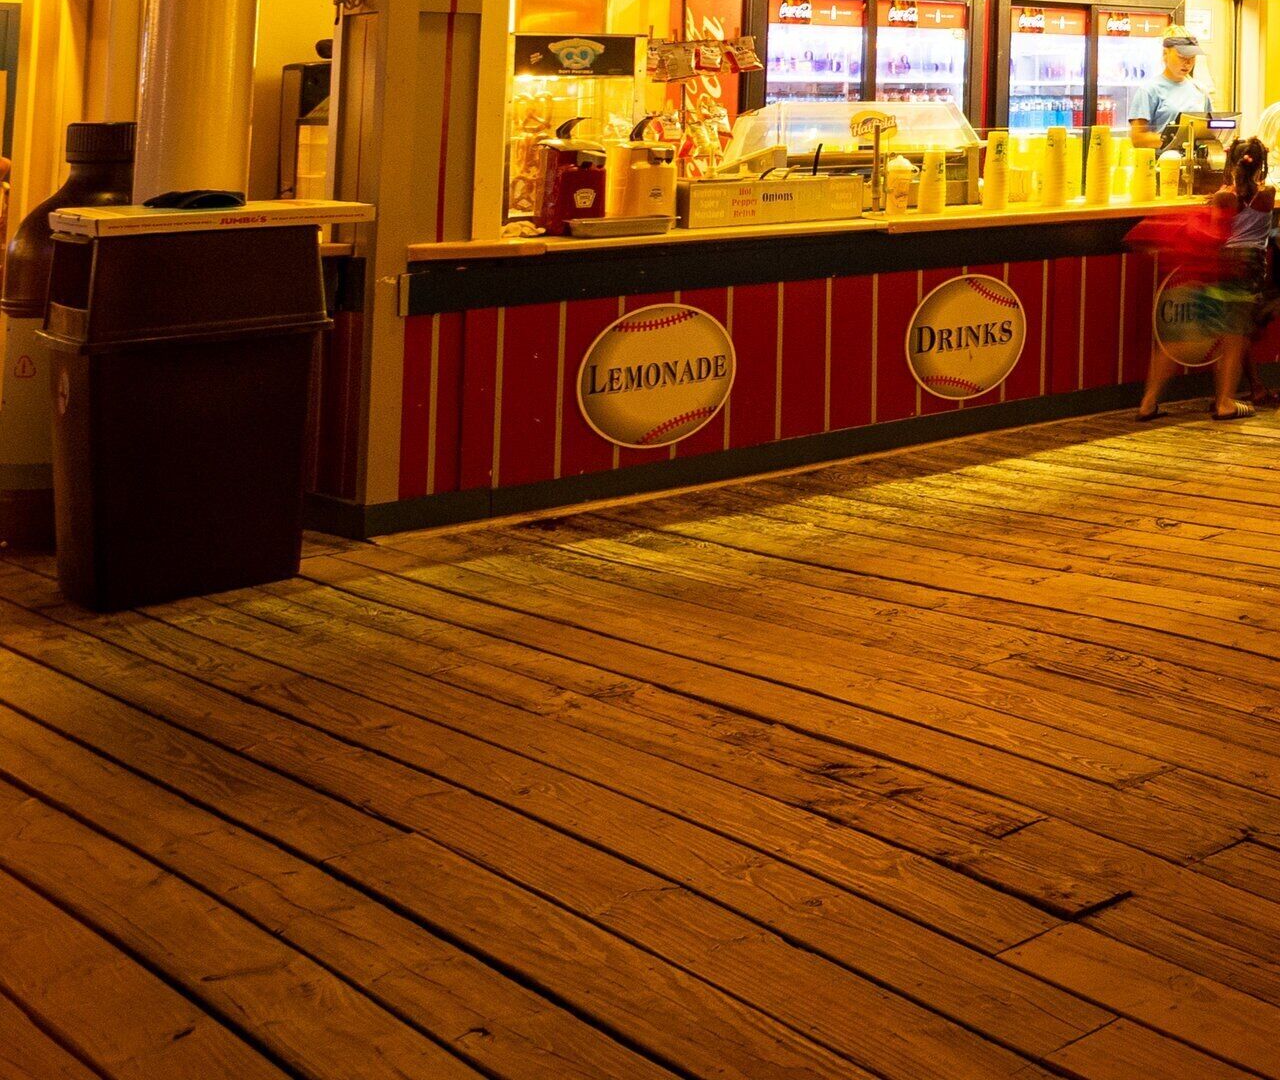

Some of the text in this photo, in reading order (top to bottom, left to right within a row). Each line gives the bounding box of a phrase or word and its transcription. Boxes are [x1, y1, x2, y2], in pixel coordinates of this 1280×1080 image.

[731, 197, 757, 208] Pepper
[762, 191, 794, 203] Onions
[915, 319, 1014, 354] DRINKS
[588, 354, 727, 396] LEMONADE
